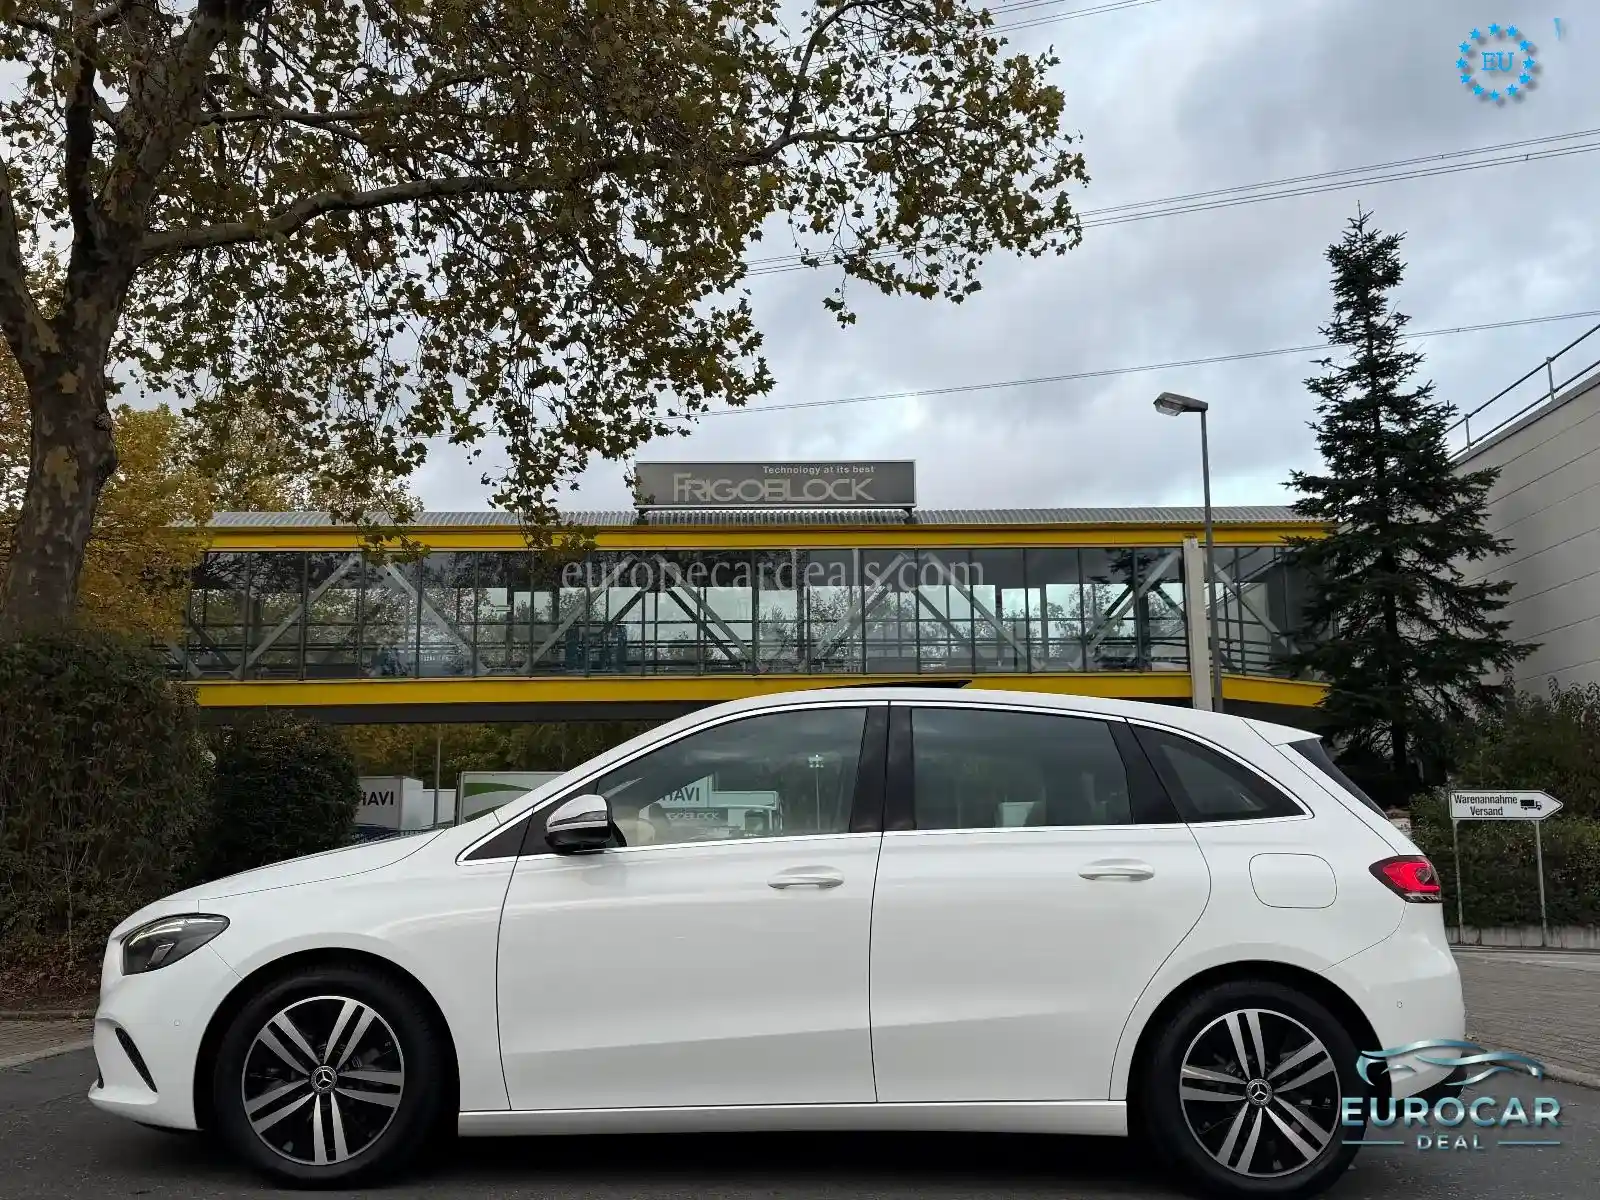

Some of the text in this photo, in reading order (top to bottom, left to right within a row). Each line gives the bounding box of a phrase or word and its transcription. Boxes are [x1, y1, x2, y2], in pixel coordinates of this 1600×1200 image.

[763, 465, 875, 475] Technology at its best
[673, 472, 875, 502] FRIGOBLOCK
[1453, 793, 1518, 805] Warenannahme
[1469, 806, 1504, 816] Versand
